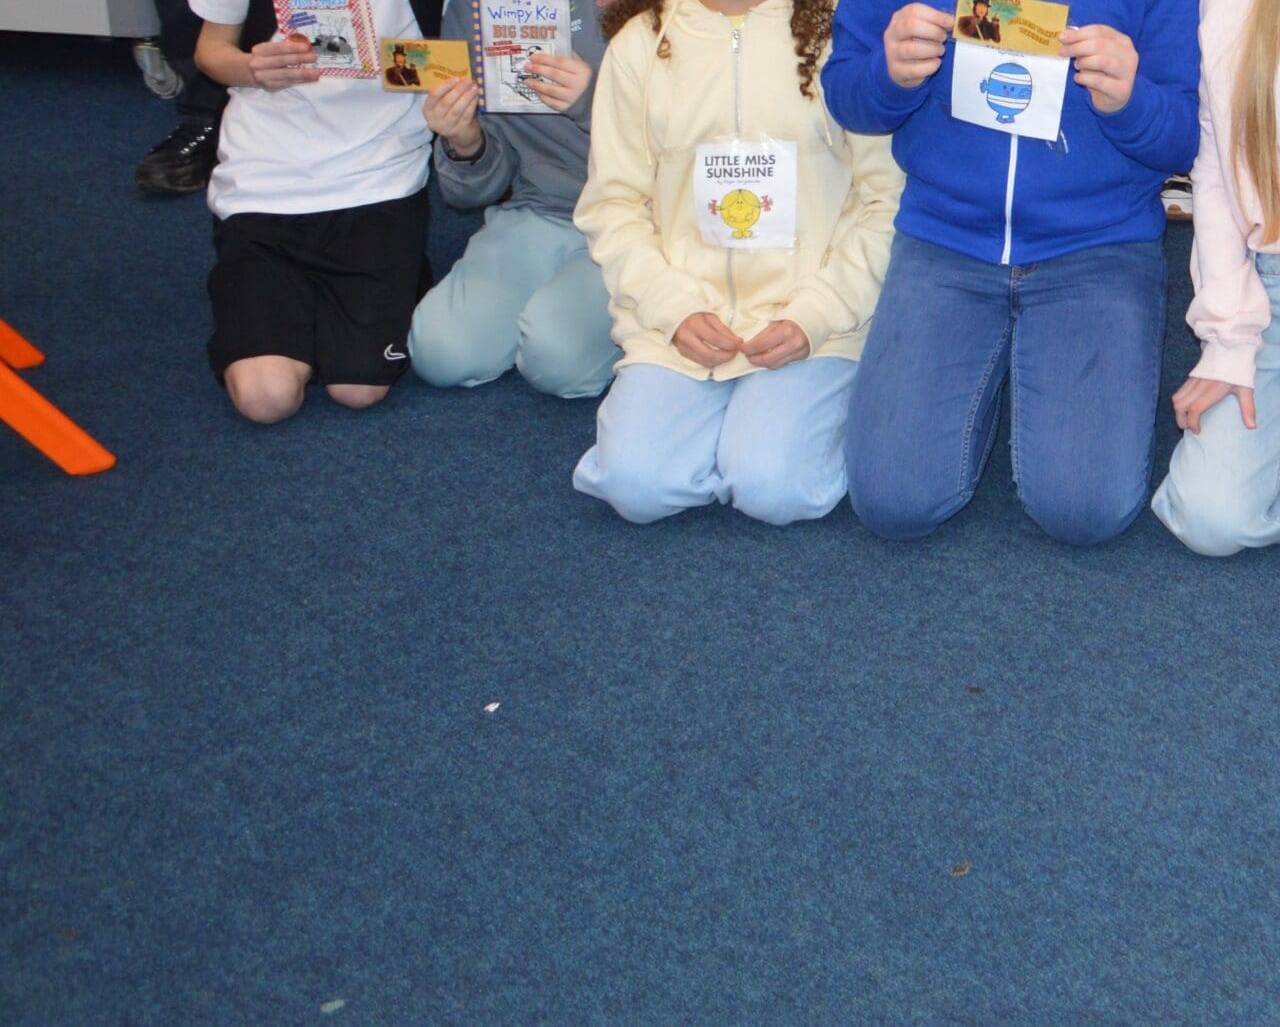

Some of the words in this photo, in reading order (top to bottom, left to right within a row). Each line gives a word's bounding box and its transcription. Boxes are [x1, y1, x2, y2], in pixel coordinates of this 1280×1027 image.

[487, 6, 532, 23] Wimpy
[536, 5, 557, 21] Kid
[493, 25, 517, 39] BIG
[520, 25, 558, 40] SHOT
[704, 155, 740, 167] LITTLE
[745, 154, 776, 166] MISS
[706, 166, 774, 179] SUNSHINE
